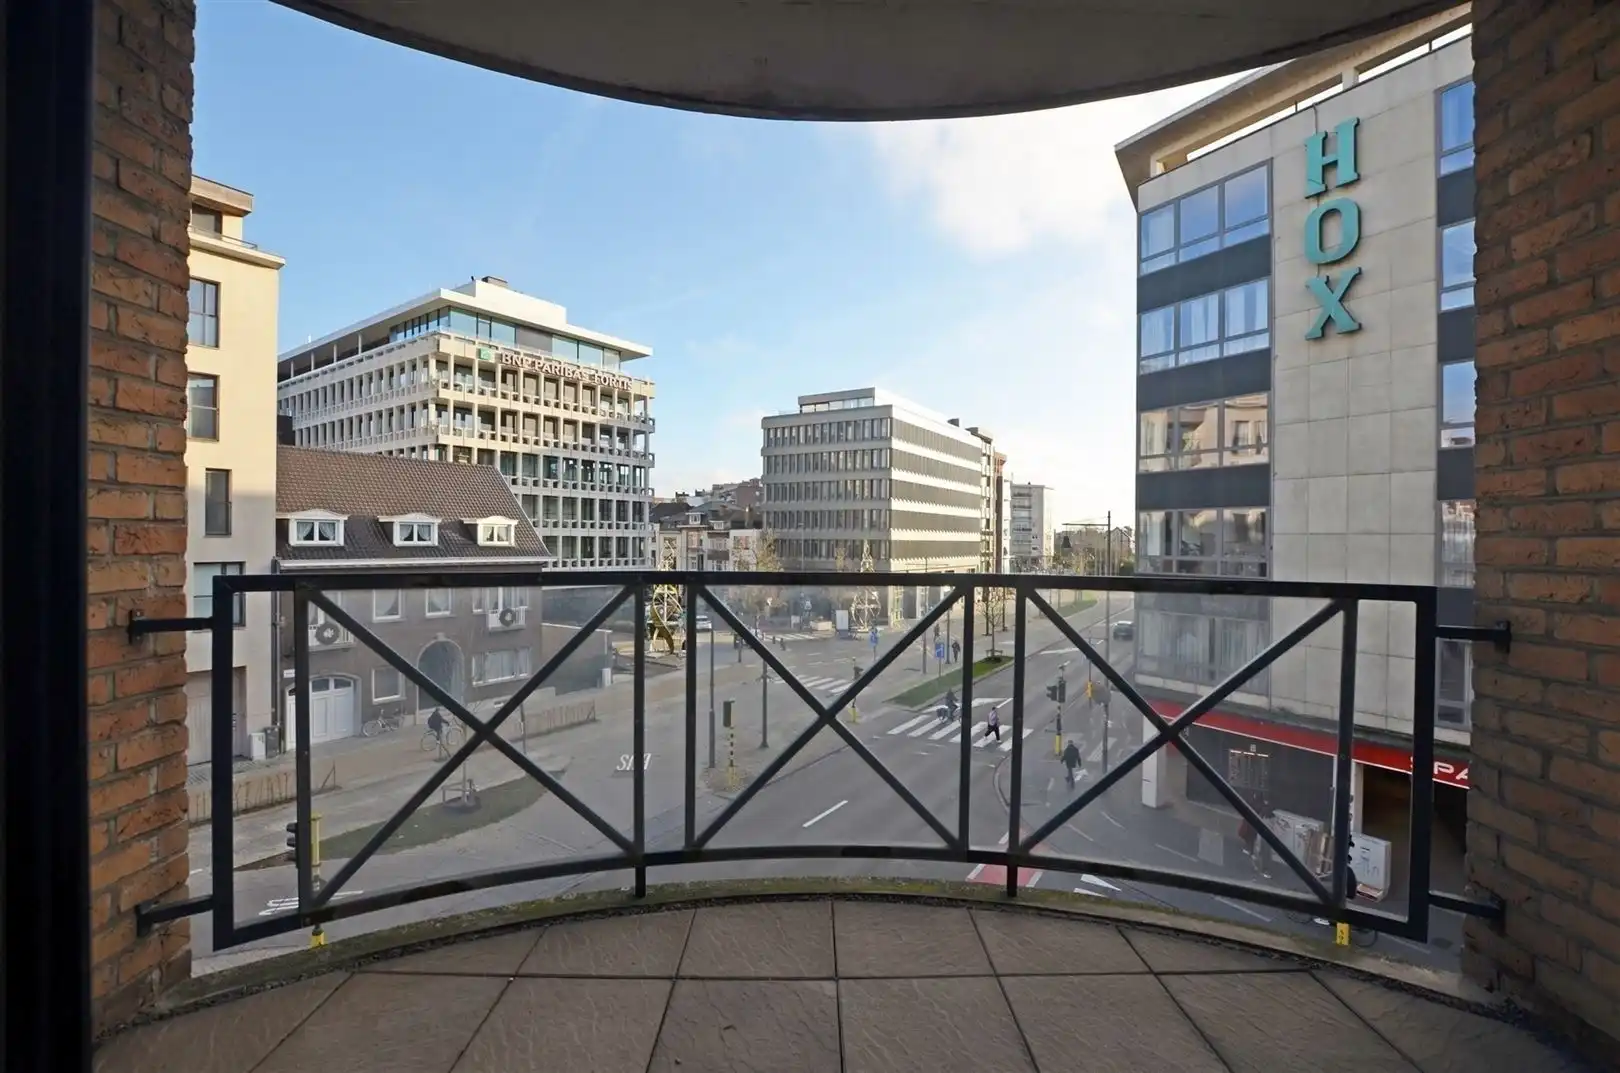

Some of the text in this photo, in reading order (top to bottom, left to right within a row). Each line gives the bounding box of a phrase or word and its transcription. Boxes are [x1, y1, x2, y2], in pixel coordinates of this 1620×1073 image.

[1304, 116, 1362, 341] HOX
[502, 352, 633, 391] BNP PARIBAS FORTIS
